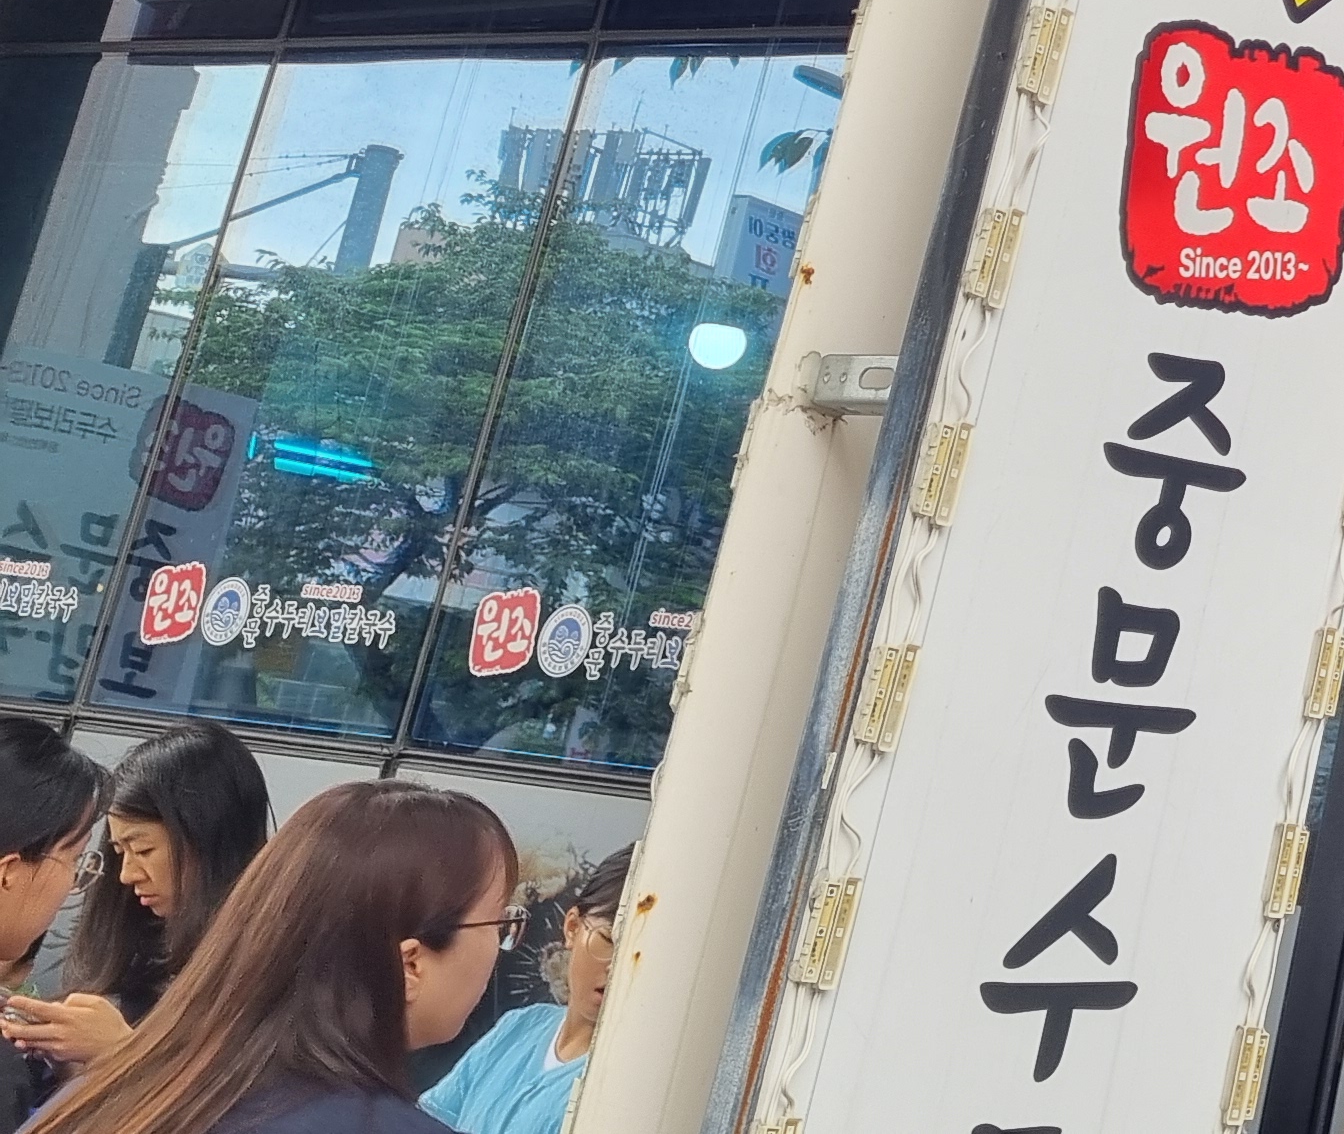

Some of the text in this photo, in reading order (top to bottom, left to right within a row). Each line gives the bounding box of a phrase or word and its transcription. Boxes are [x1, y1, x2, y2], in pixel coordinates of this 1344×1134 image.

[1144, 41, 1314, 236] 원조
[1179, 247, 1310, 281] Since 2013~
[148, 577, 198, 632] 원조
[477, 600, 532, 662] 원조
[651, 608, 694, 628] since2
[608, 627, 681, 670] 수두리보
[971, 351, 1247, 1134] 중문수
